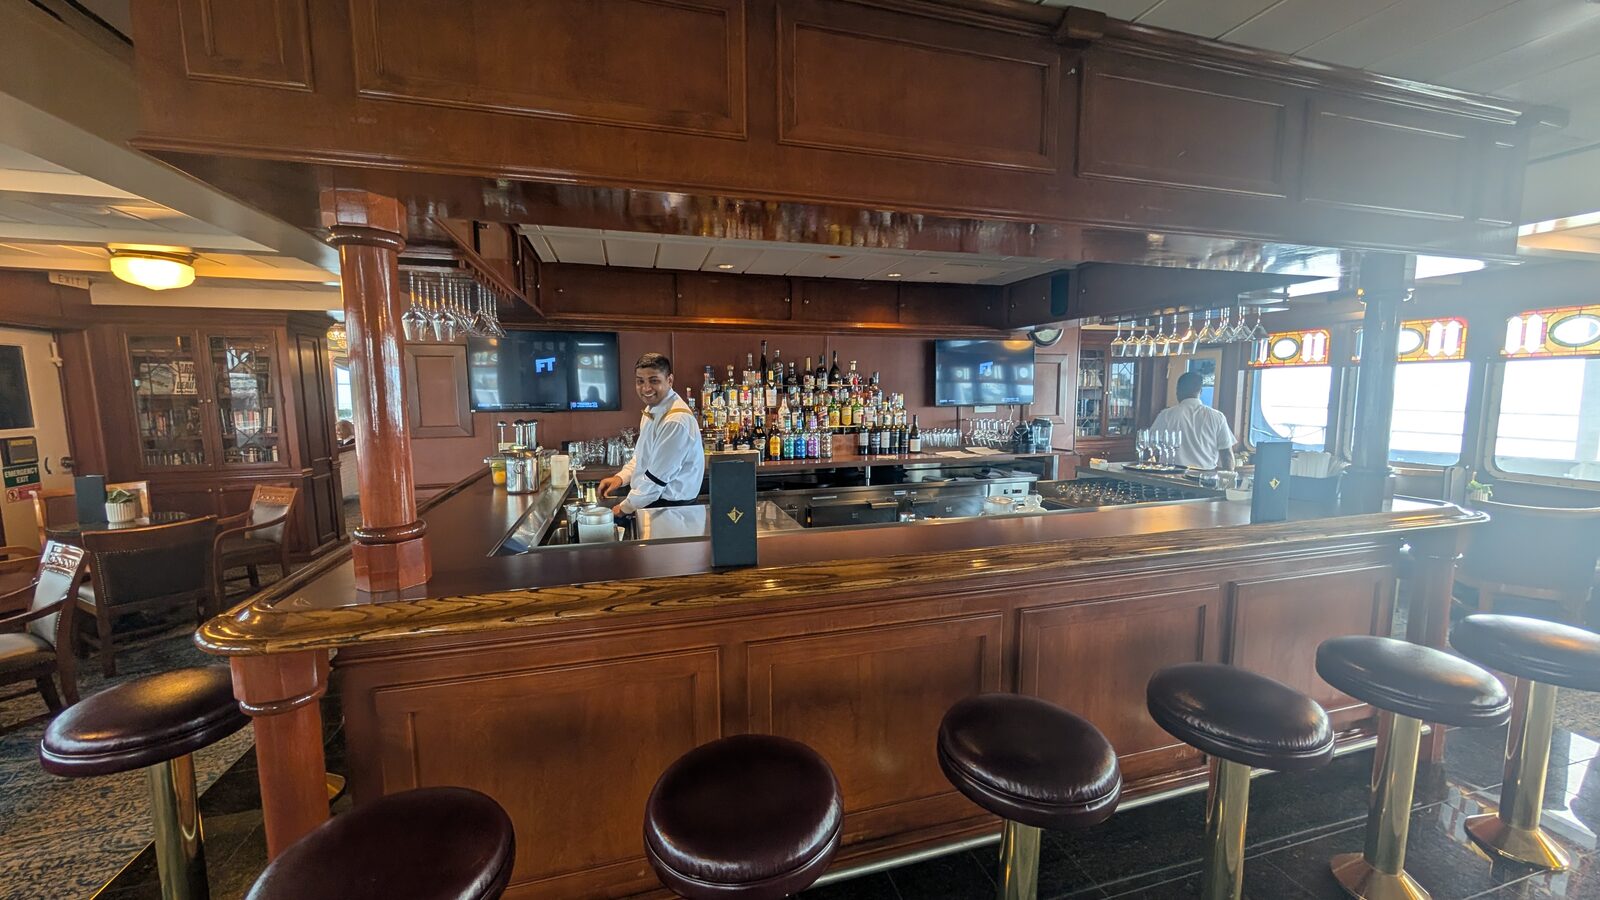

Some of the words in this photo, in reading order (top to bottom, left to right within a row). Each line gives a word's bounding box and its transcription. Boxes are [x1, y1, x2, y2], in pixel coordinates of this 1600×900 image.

[57, 274, 81, 286] EXIT
[535, 357, 556, 373] FT
[4, 467, 38, 478] EMERGENCY
[16, 476, 29, 484] EXIT
